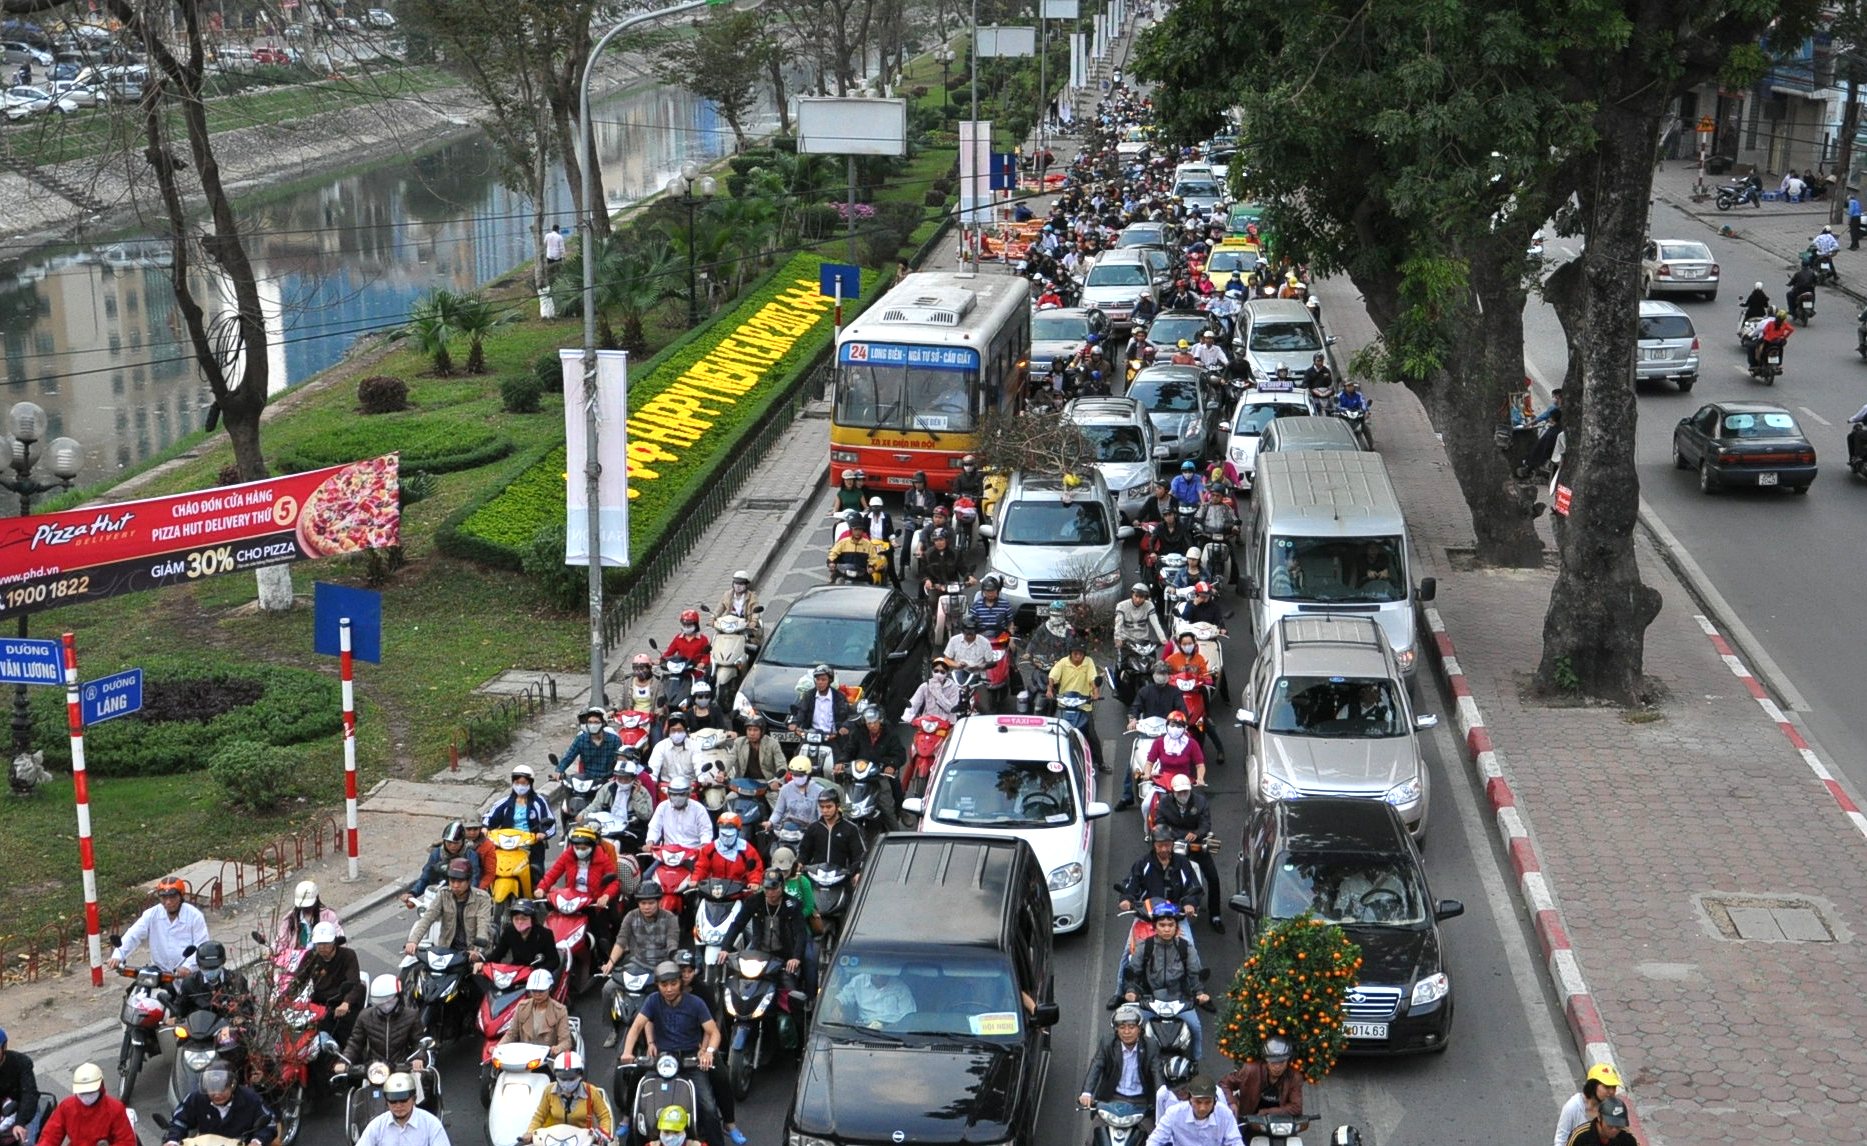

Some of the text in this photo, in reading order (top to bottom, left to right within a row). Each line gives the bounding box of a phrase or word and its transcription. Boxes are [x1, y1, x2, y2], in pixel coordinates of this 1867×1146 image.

[713, 324, 797, 364] YEAR
[850, 345, 867, 359] 24
[677, 351, 767, 395] NEW
[626, 381, 736, 448] HAPPY
[224, 491, 245, 508] CỬA
[245, 489, 273, 504] HÀNG
[30, 512, 135, 551] Pizza Hut
[152, 500, 291, 542] PIZZA HUT DELIVERY THỨ 5
[75, 530, 136, 546] DELIVERY
[151, 559, 185, 578] GIẢM
[186, 545, 234, 578] 30%
[236, 547, 262, 562] CHO
[263, 542, 295, 557] PIZZA
[6, 576, 89, 608] 1900 1822
[6, 643, 49, 656] ĐƯỜNG
[0, 659, 56, 679] VĂN LƯƠNG
[102, 676, 136, 693] ĐƯỜNG
[1011, 717, 1030, 725] TAXI
